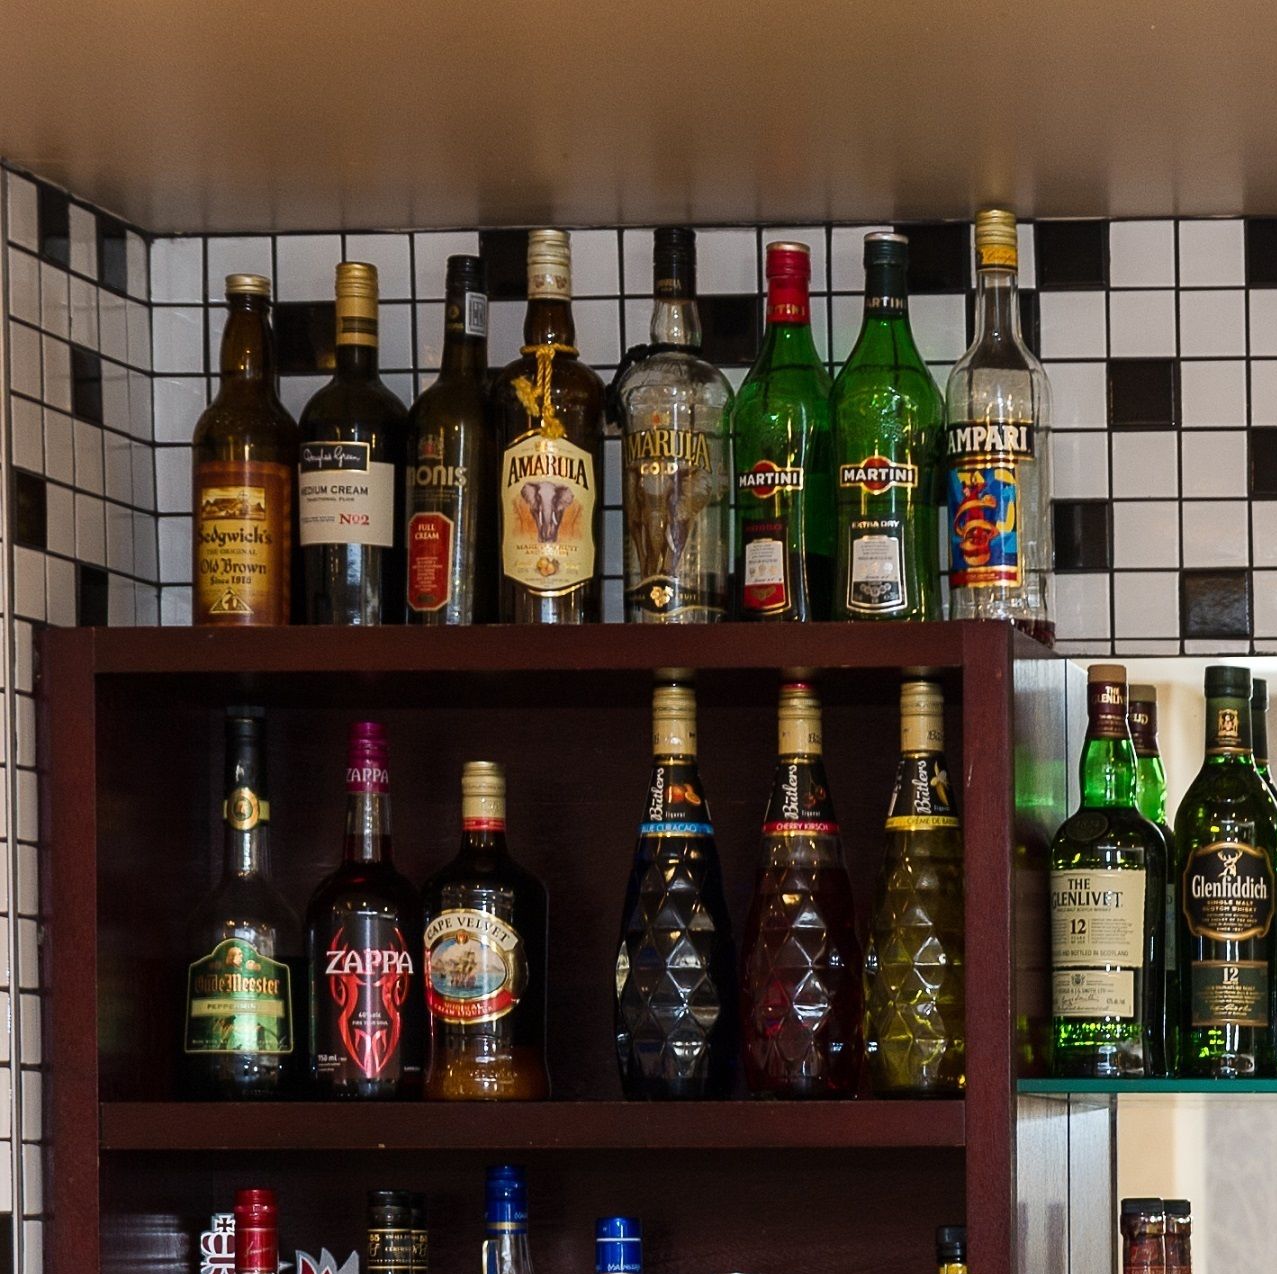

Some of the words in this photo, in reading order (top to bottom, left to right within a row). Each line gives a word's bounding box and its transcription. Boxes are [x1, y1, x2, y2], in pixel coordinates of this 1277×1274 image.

[947, 425, 1028, 456] AMPARI
[627, 428, 713, 473] MARULA
[507, 455, 589, 490] AMARULA
[641, 462, 679, 475] GOLD
[843, 468, 914, 482] MARTINI
[739, 472, 799, 488] MARTINI
[331, 485, 369, 496] CREAM
[852, 520, 879, 528] EXTRA
[881, 519, 900, 528] DRY
[198, 525, 273, 548] Sedgwick's
[415, 532, 439, 540] CREAM
[201, 558, 219, 574] Old
[221, 558, 268, 575] Brown
[346, 767, 389, 784] ZAPPA
[776, 823, 802, 832] CHERRY
[803, 823, 829, 832] KIRSCH
[1067, 878, 1091, 890] THE
[1192, 875, 1267, 899] Glenfiddich
[427, 916, 453, 940] CAPE
[456, 915, 511, 943] VELVET
[1070, 919, 1087, 935] 12
[325, 949, 415, 975] ZAPPA
[1222, 967, 1239, 982] 12
